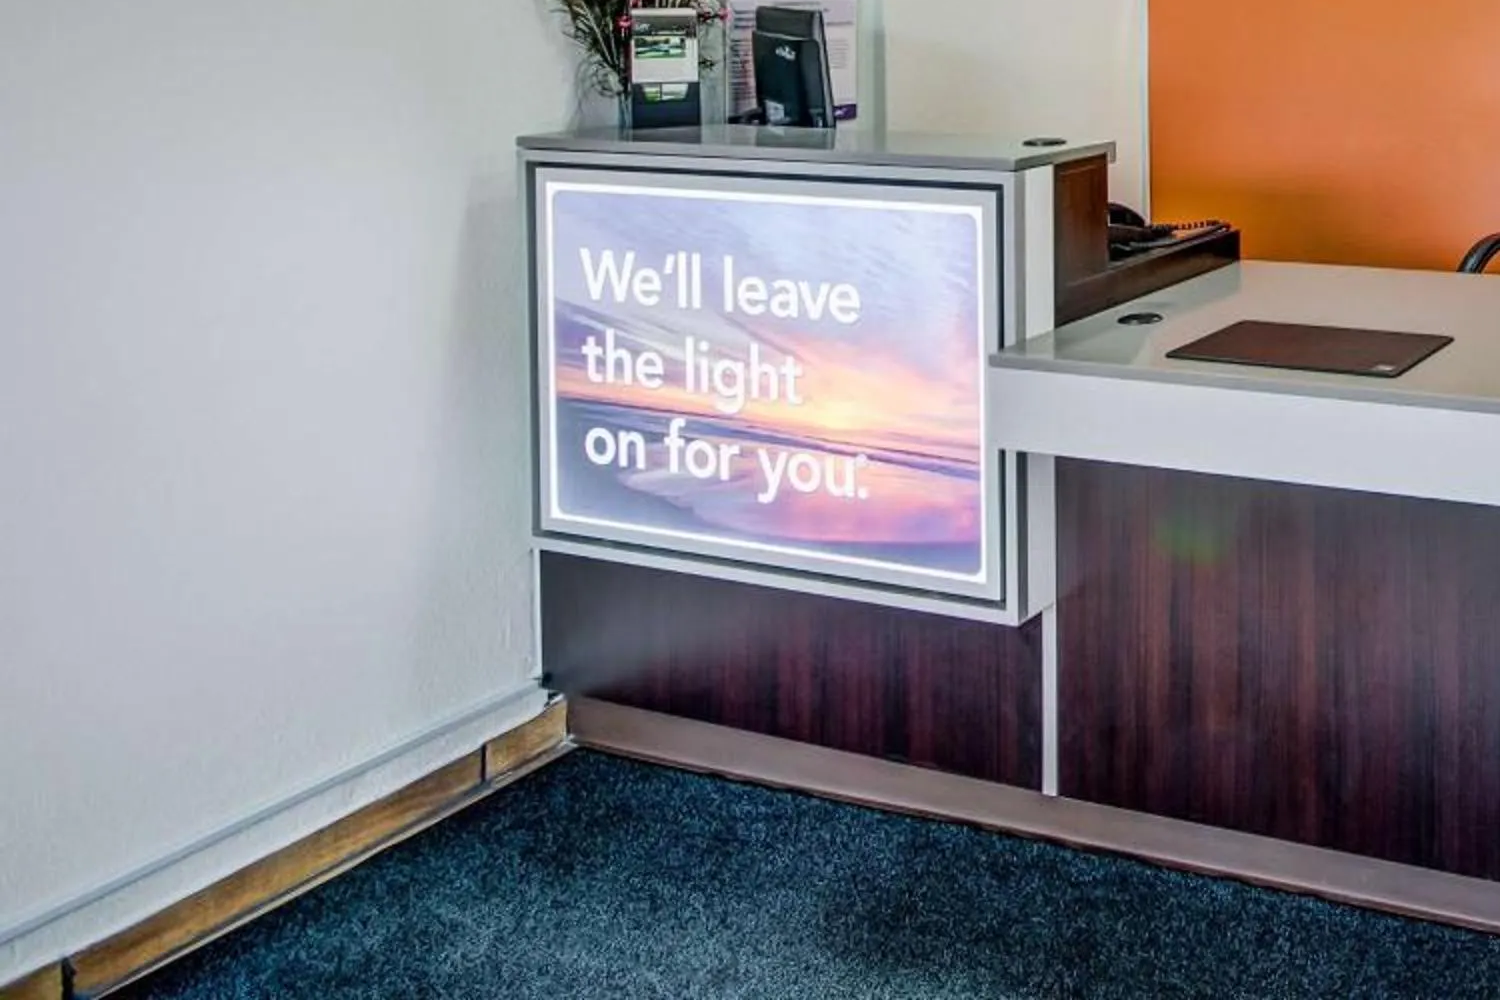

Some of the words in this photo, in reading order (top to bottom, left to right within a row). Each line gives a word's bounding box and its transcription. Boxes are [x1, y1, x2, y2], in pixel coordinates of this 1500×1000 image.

[580, 247, 701, 309] We'll
[723, 255, 861, 324] leave
[581, 328, 664, 389] the
[686, 336, 801, 414] light
[585, 426, 646, 470] on
[664, 418, 739, 481] for
